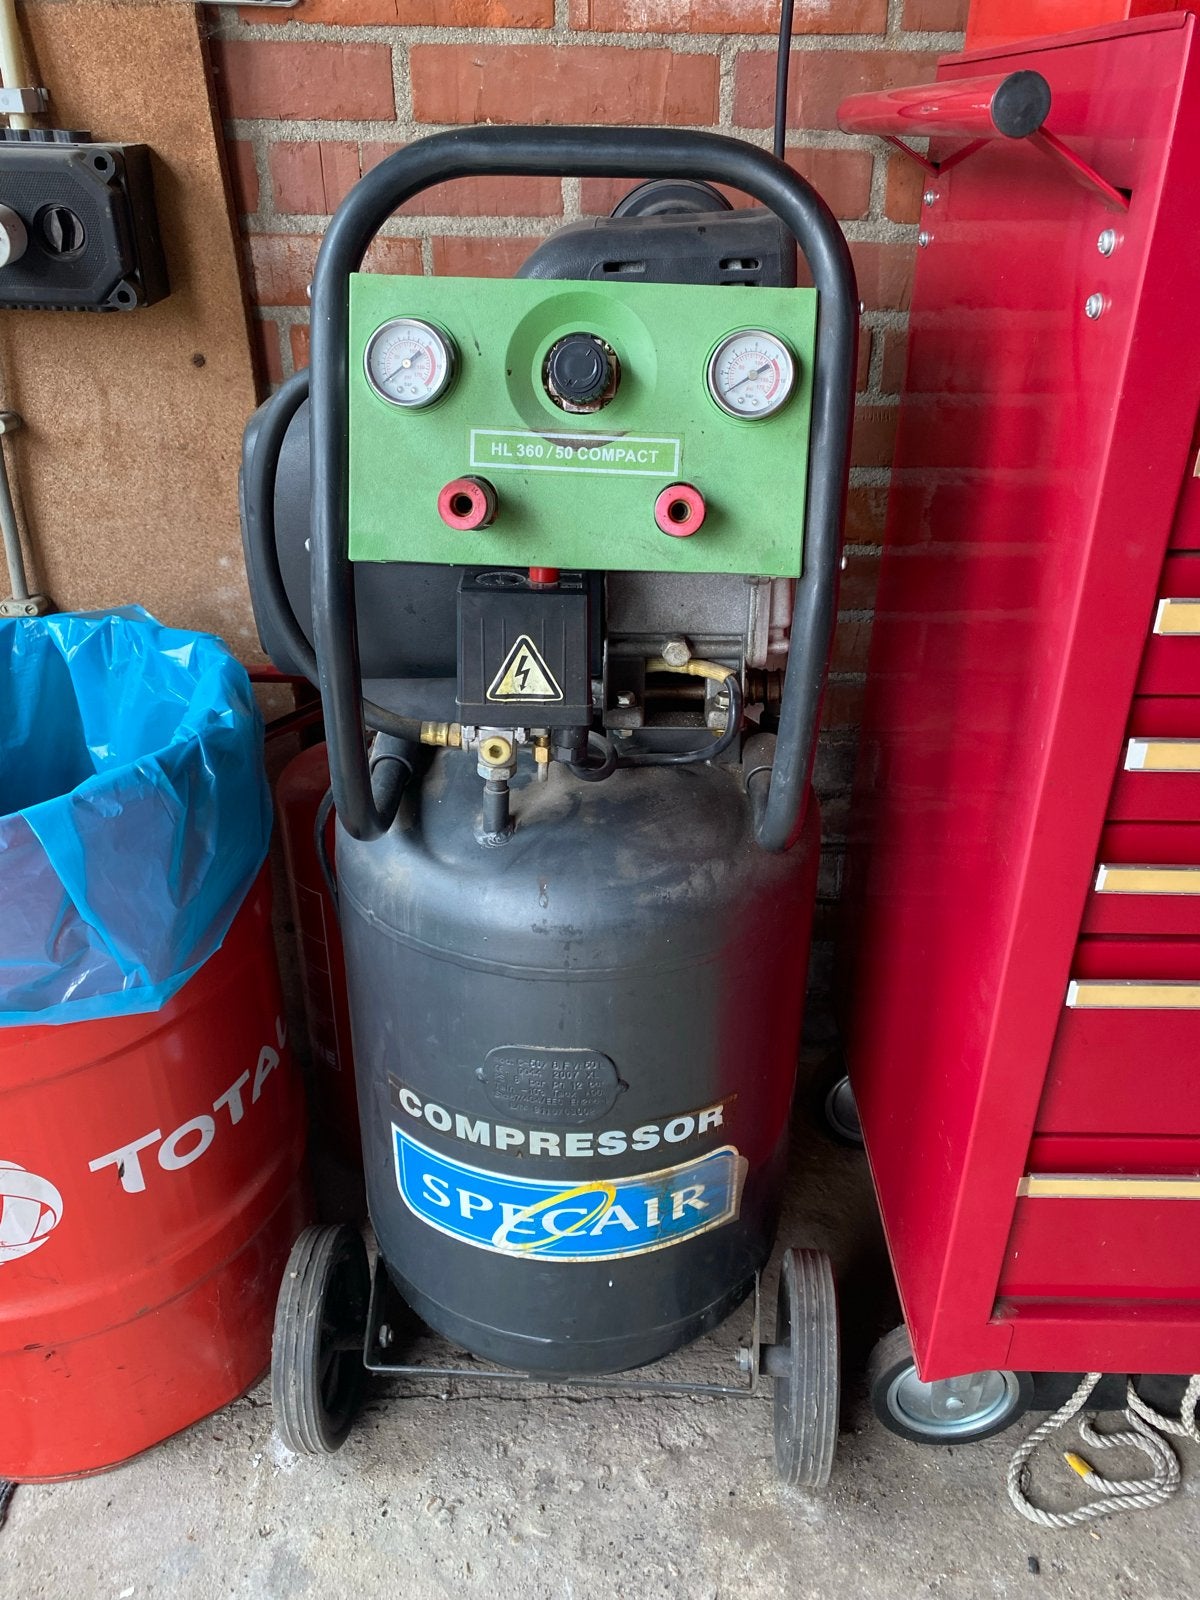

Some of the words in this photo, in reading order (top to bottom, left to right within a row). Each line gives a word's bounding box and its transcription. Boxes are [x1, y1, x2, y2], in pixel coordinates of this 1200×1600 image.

[491, 442, 513, 457] HL
[577, 448, 659, 463] COMPACT
[399, 1088, 724, 1157] COMPRESSOR
[422, 1174, 711, 1250] SPECAIR
